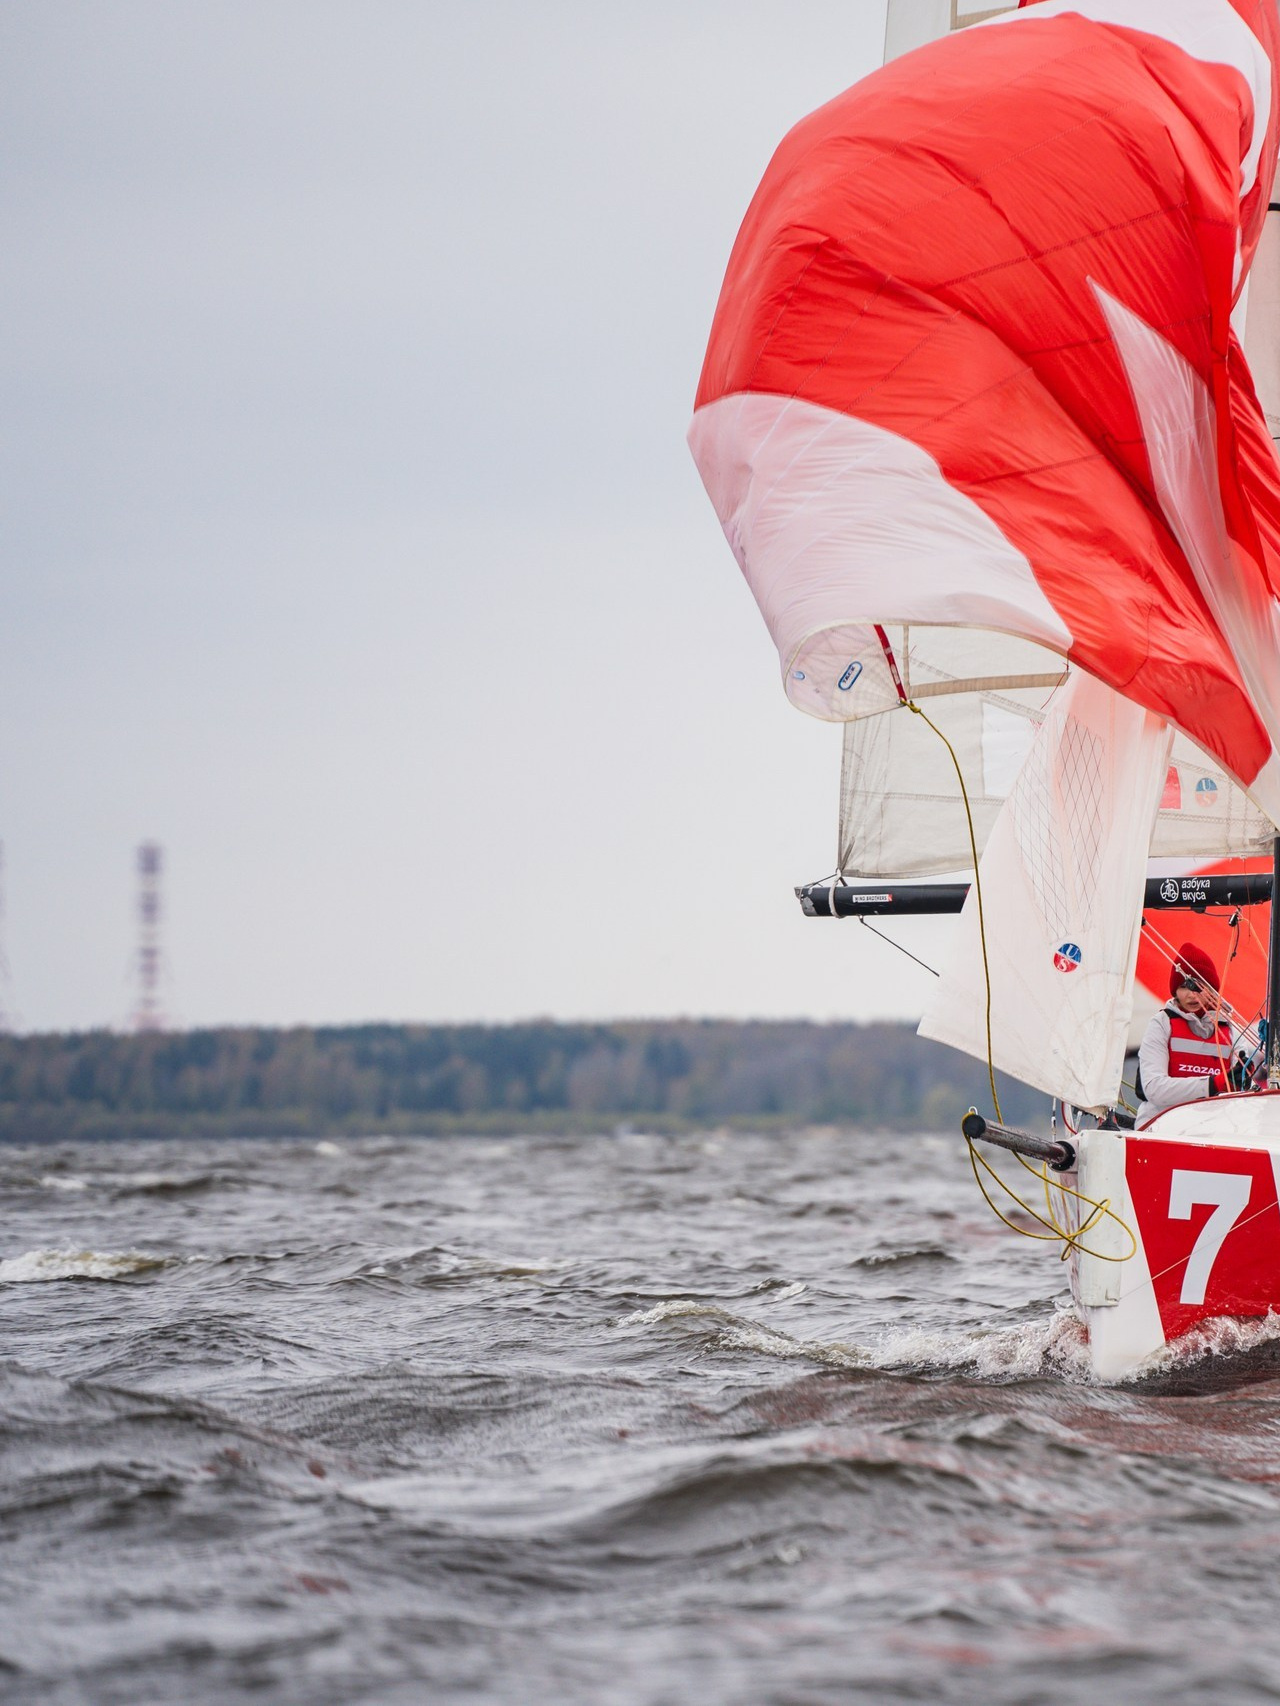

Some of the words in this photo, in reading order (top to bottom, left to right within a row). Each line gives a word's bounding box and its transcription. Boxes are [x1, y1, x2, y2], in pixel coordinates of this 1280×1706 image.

[1181, 877, 1210, 891] азбука
[1181, 891, 1206, 903] вкуса
[1178, 1063, 1221, 1076] ZIGZAG
[1167, 1168, 1254, 1306] 7
